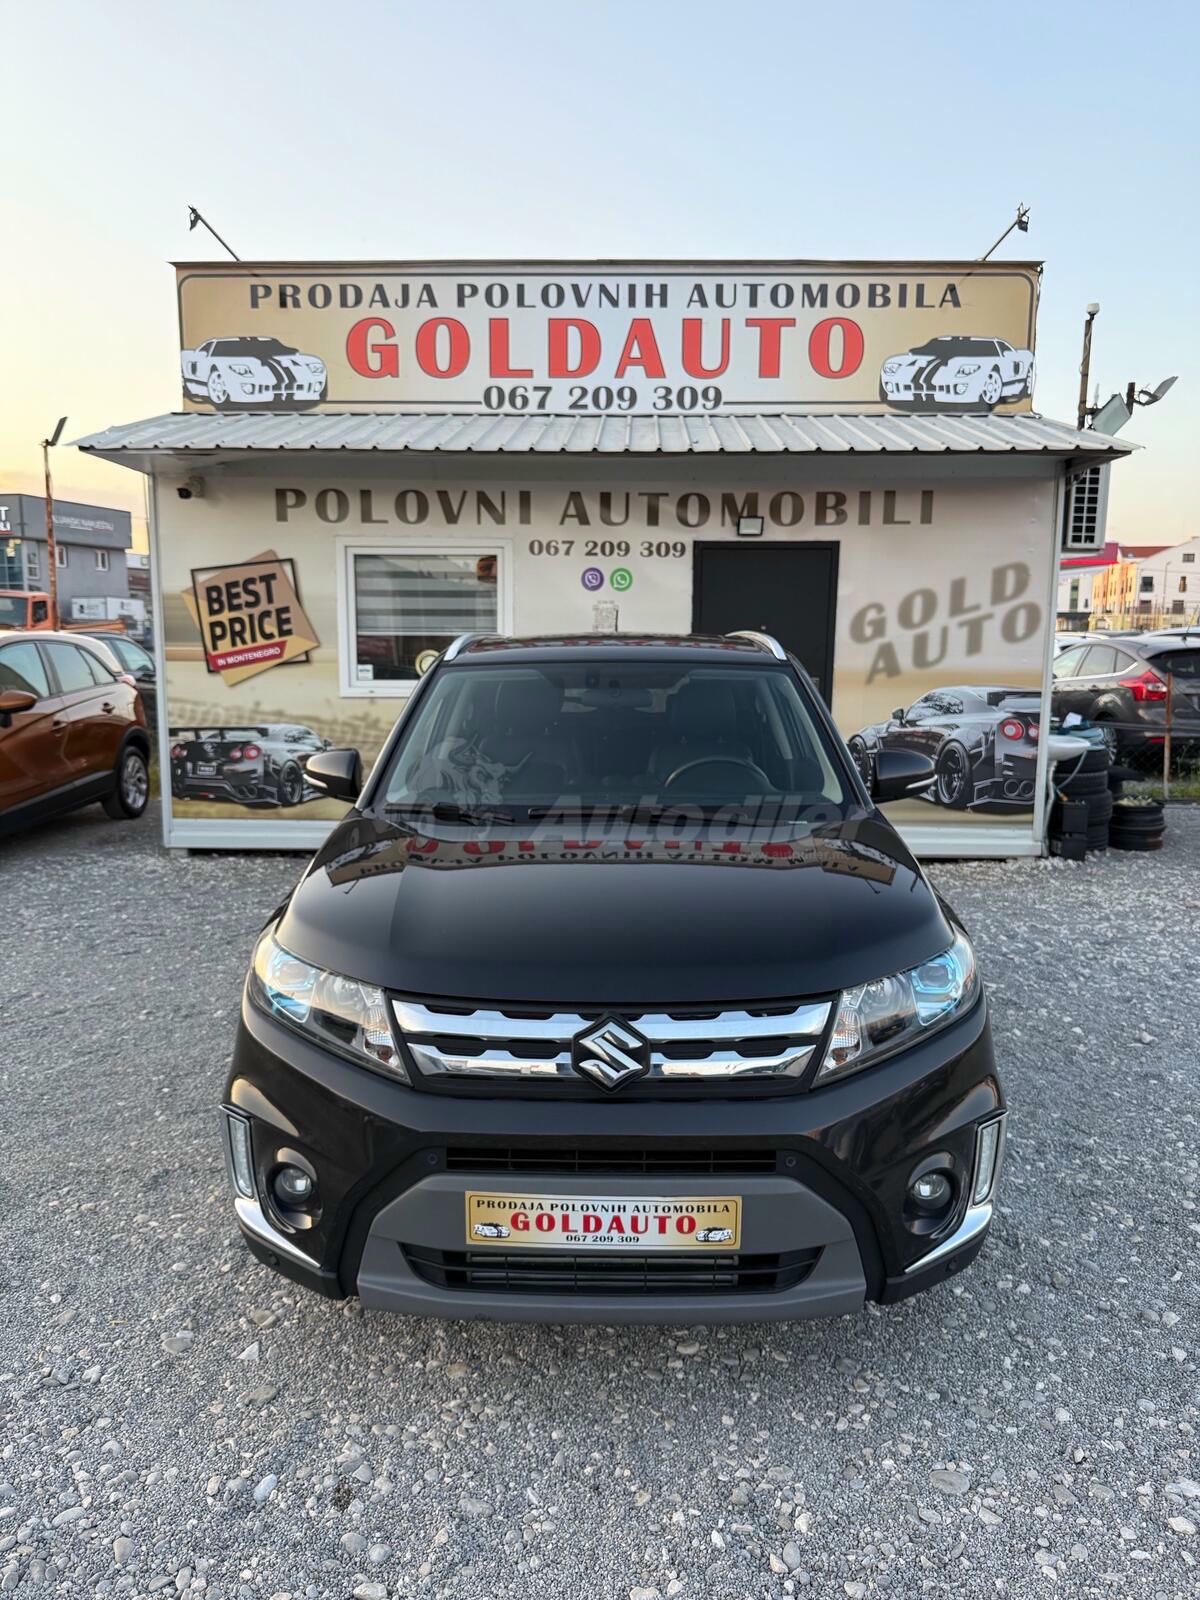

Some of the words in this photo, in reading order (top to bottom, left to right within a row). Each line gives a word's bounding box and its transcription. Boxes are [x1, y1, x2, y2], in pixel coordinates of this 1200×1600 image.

[250, 283, 439, 309] PRODAJA
[456, 283, 669, 309] POLOVNIH
[686, 283, 962, 309] AUTOMOBILA
[345, 316, 865, 380] GOLDAUTO
[483, 385, 553, 411] 067
[568, 385, 638, 411] 209
[652, 385, 723, 411] 309
[275, 488, 532, 526] POLOVNI
[559, 490, 935, 528] AUTOMOBILI
[529, 539, 575, 557] 067
[585, 540, 630, 557] 209
[640, 541, 686, 558] 309
[206, 573, 277, 617] BEST
[849, 561, 1030, 644] GOLD
[209, 606, 293, 651] PRICE
[866, 602, 1041, 685] AUTO
[217, 656, 227, 667] IN
[228, 647, 281, 665] MONTENEGRO
[476, 1199, 544, 1211] PRODAJA
[550, 1203, 627, 1213] POLOVNIH
[633, 1204, 730, 1214] AUTOMOBILA
[510, 1212, 697, 1235] GOLDAUTO
[565, 1234, 588, 1243] 067
[592, 1235, 614, 1243] 209
[617, 1235, 640, 1244] 309
